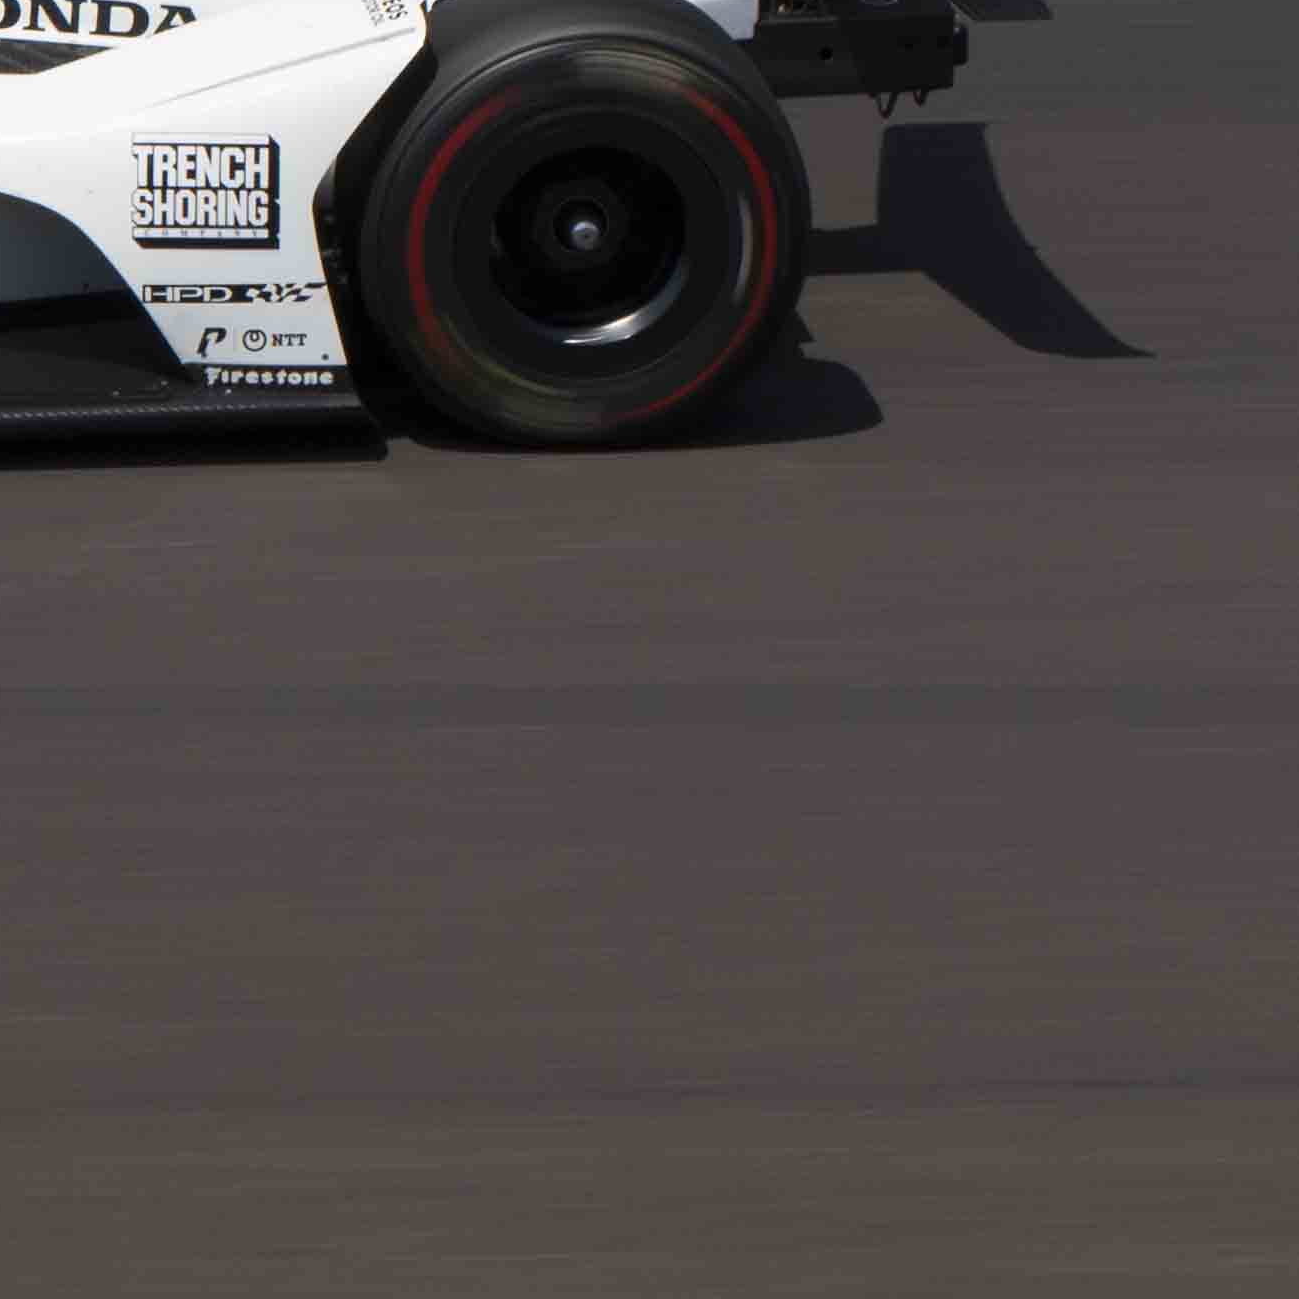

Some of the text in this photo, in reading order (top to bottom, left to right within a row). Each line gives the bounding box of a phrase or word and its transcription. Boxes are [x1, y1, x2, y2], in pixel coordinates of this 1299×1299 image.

[133, 145, 269, 189] TRENCH
[133, 188, 268, 227] SHORING
[143, 285, 233, 302] HPD
[271, 333, 308, 347] NTT
[205, 366, 334, 386] Firestone
